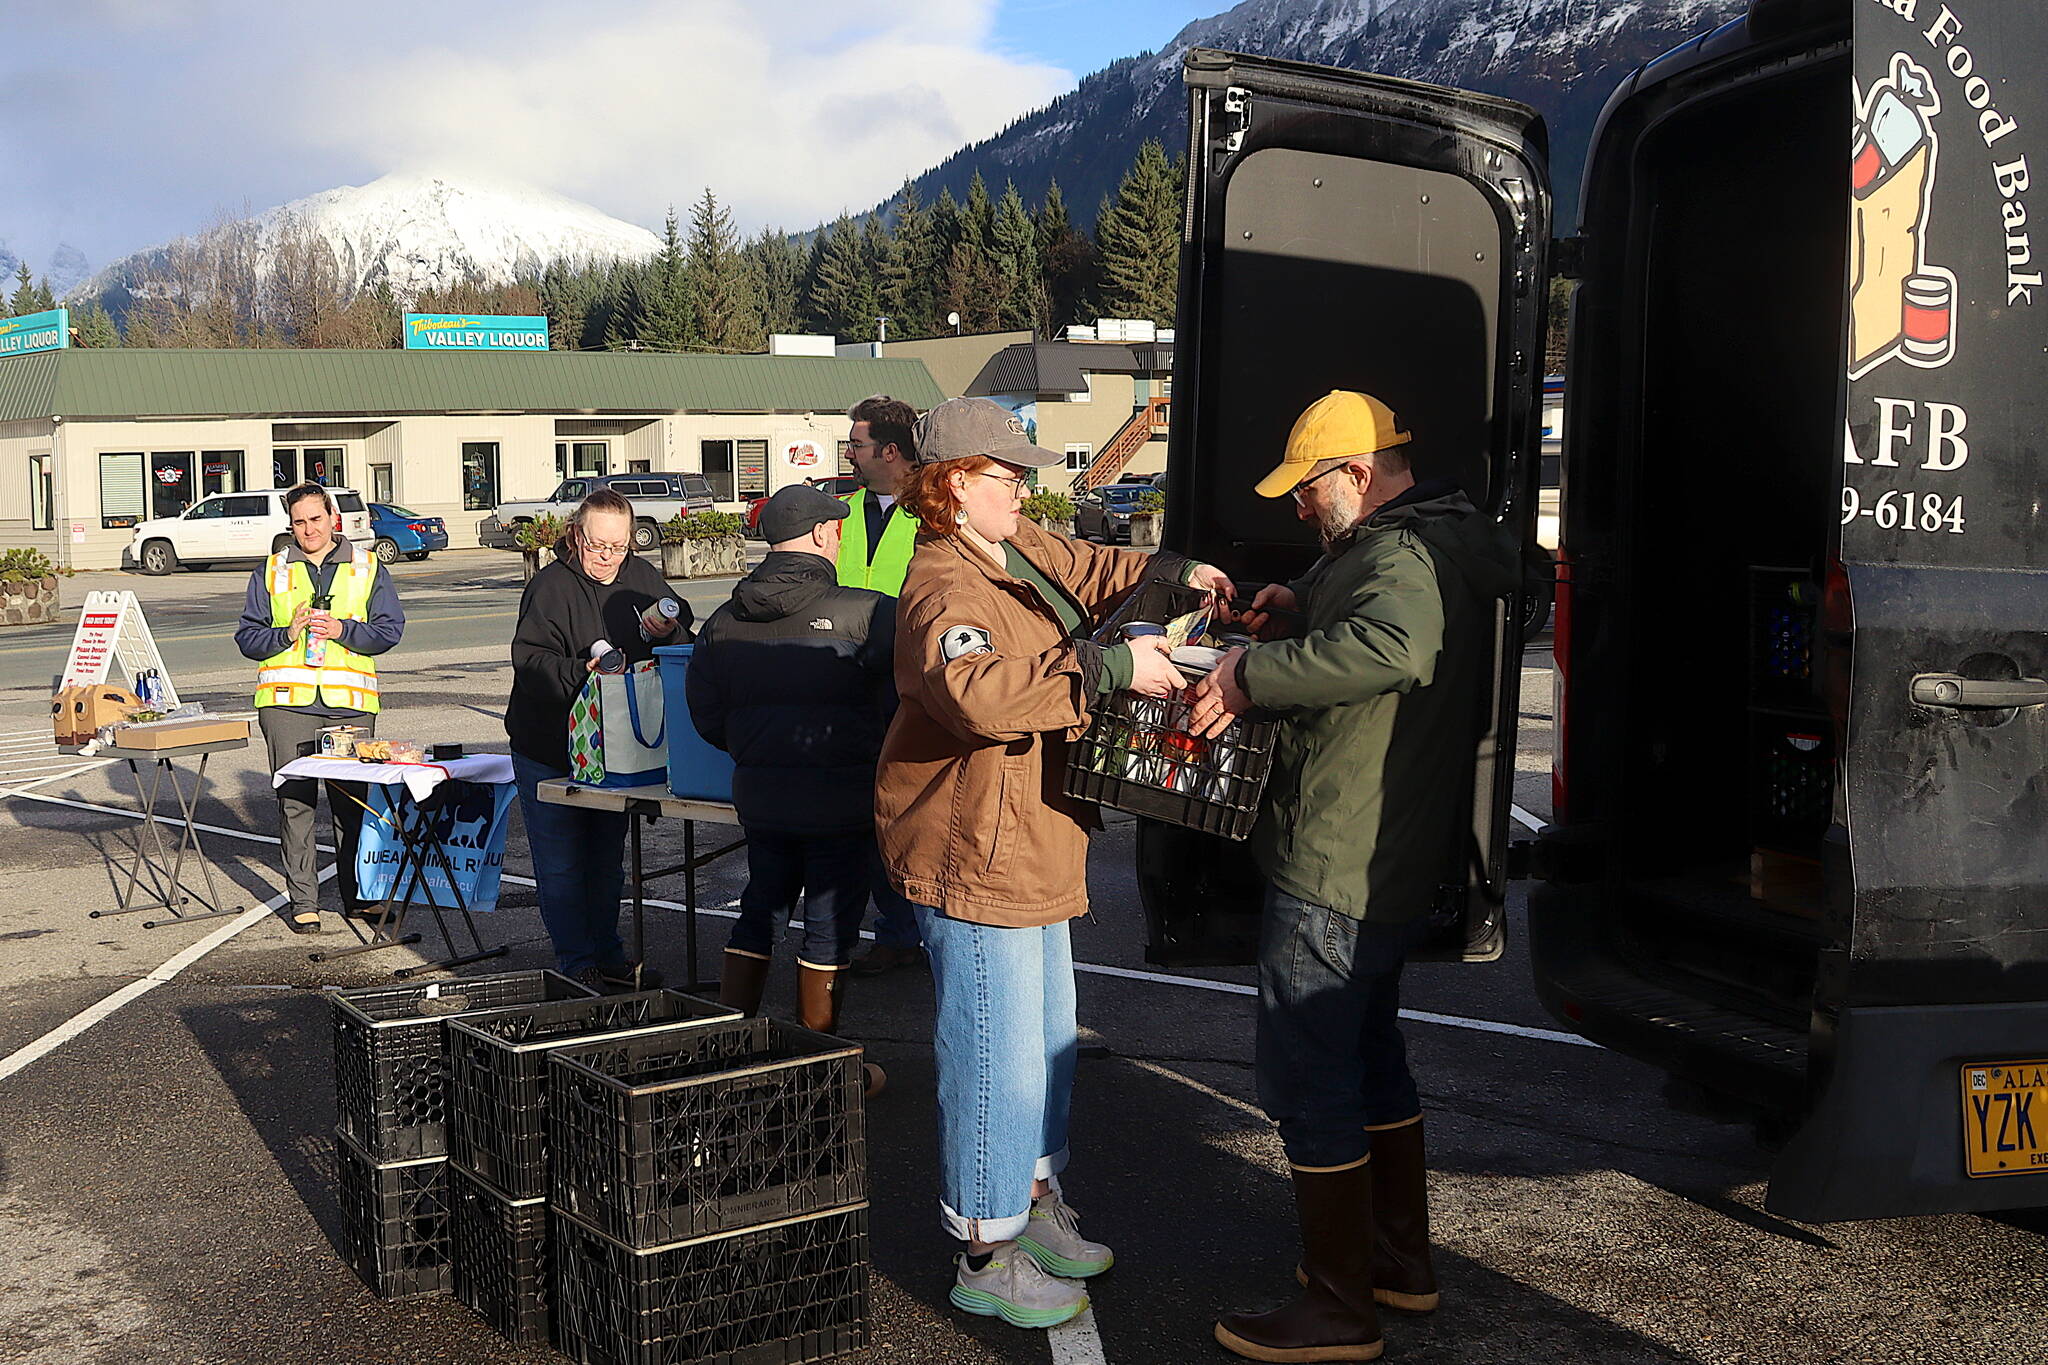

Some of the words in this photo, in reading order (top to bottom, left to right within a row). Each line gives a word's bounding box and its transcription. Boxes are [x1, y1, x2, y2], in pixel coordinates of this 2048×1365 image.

[1922, 3, 2018, 148] Food
[1992, 153, 2043, 307] Bank
[410, 317, 477, 336] Thibodeau's
[0, 335, 22, 353] LLEY
[24, 330, 59, 349] LIQUOR
[426, 332, 486, 348] VALLEY
[489, 332, 546, 348] LIQUOR
[1841, 486, 1966, 534] 9-6184
[1972, 1074, 1986, 1087] DEC
[2003, 1069, 2048, 1089] ALA
[1972, 1091, 2037, 1152] YZK
